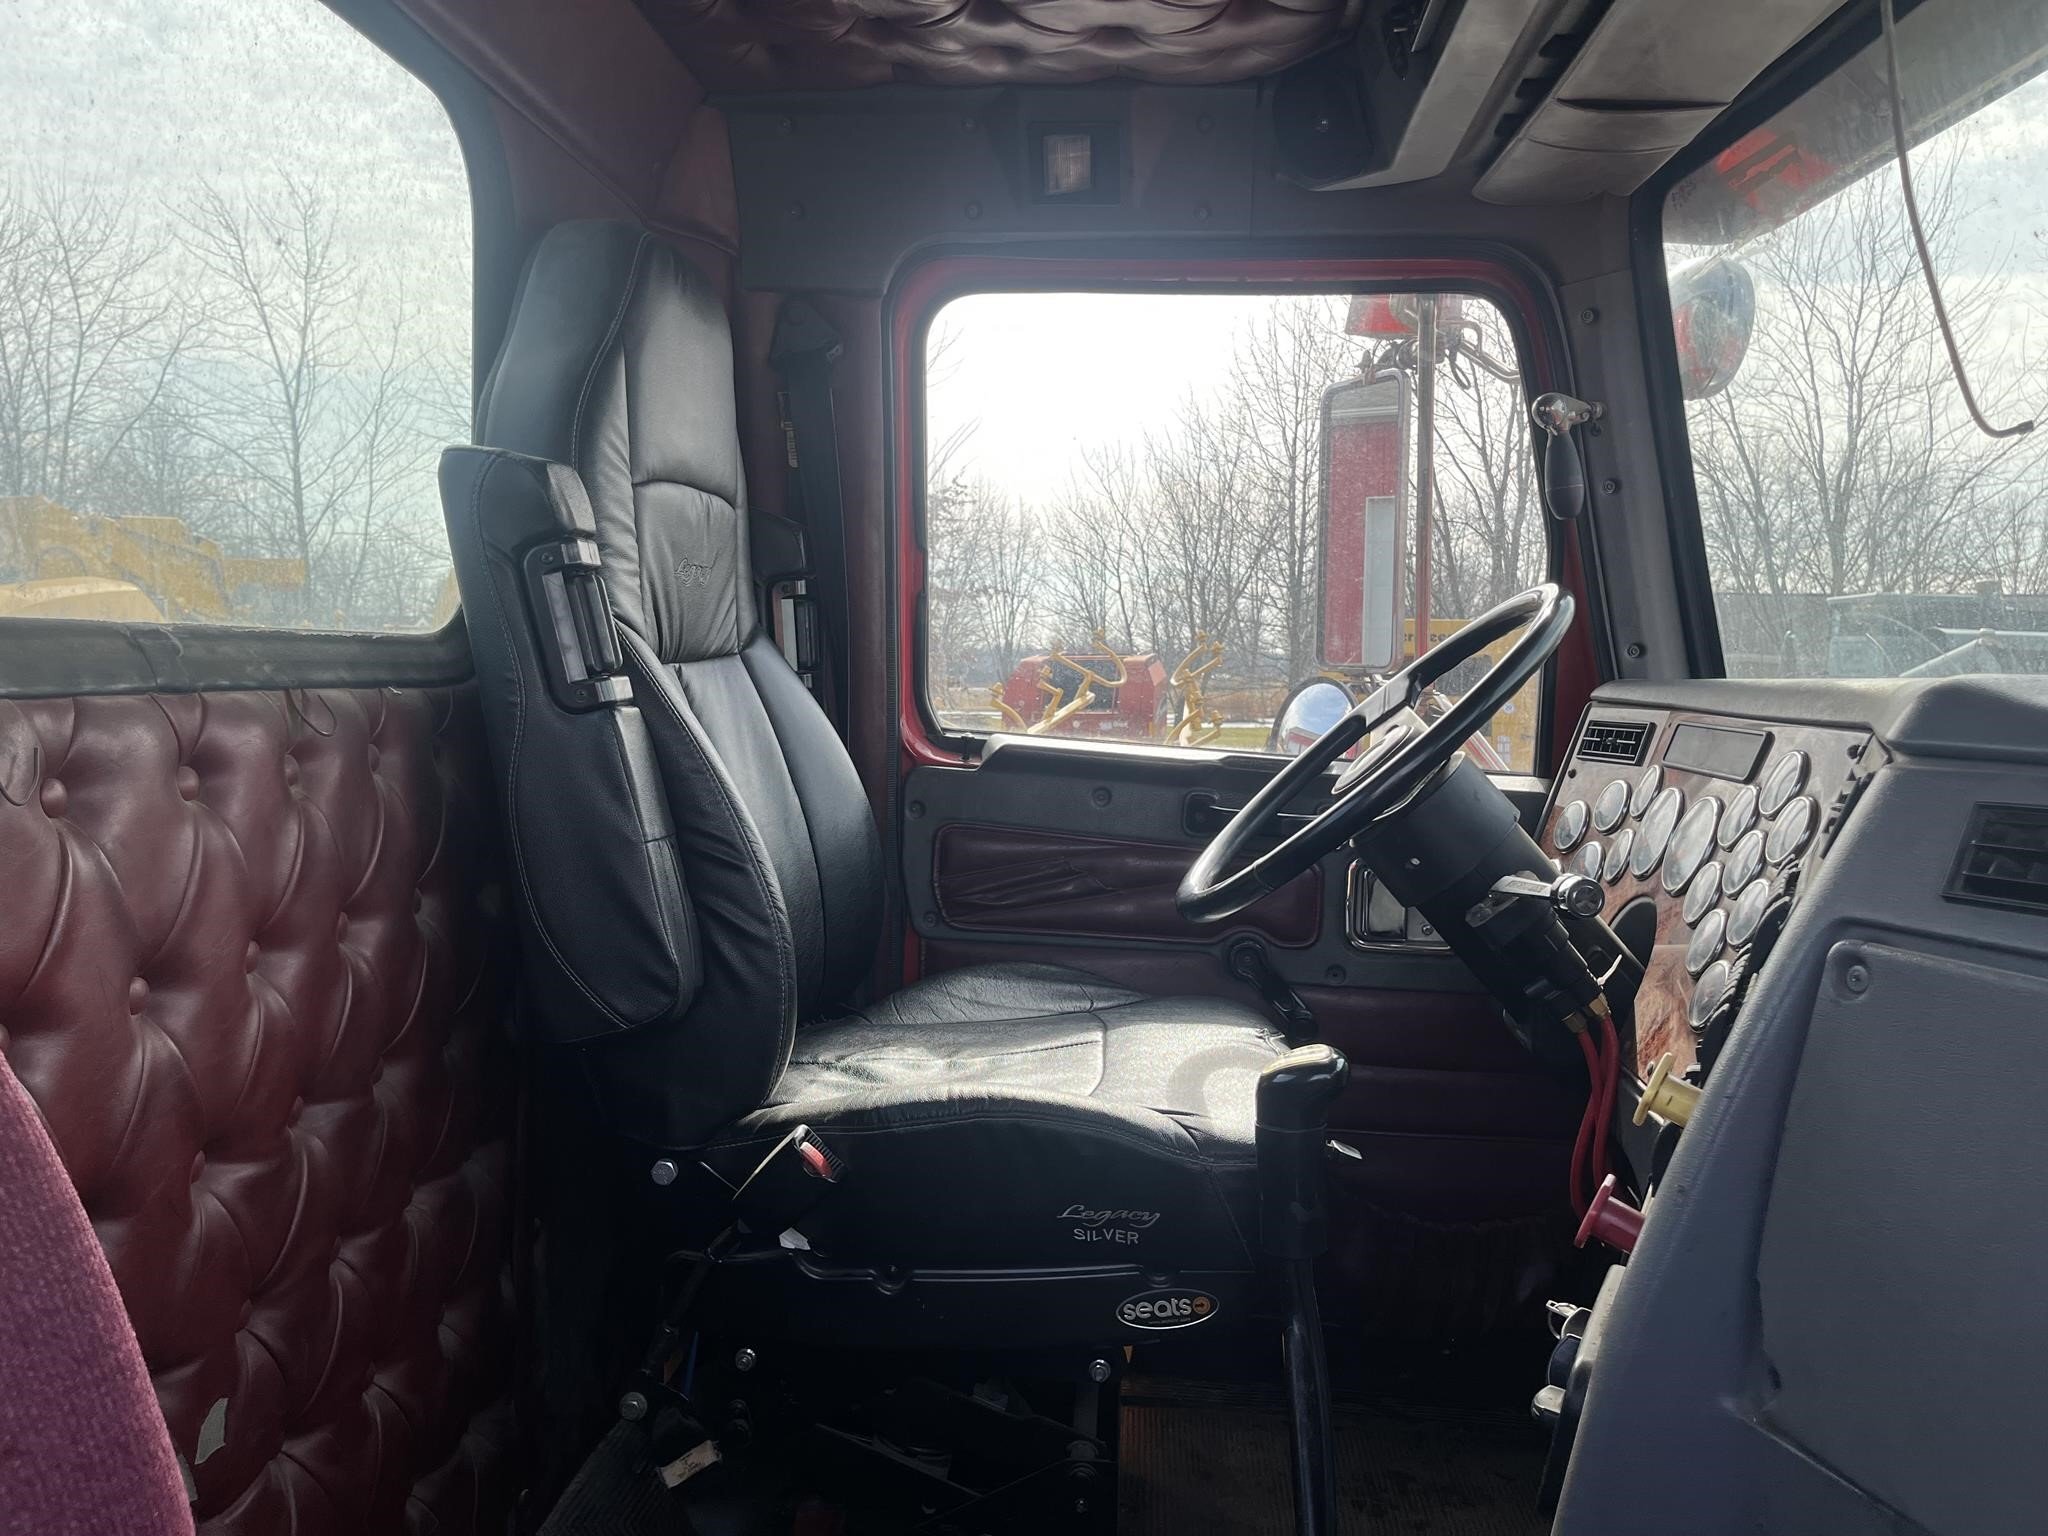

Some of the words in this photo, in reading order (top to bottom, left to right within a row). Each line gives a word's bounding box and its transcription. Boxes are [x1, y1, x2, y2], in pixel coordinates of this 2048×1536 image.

[1056, 1204, 1161, 1229] Legacy
[1073, 1228, 1140, 1245] SILVER
[1123, 1297, 1192, 1321] seats
